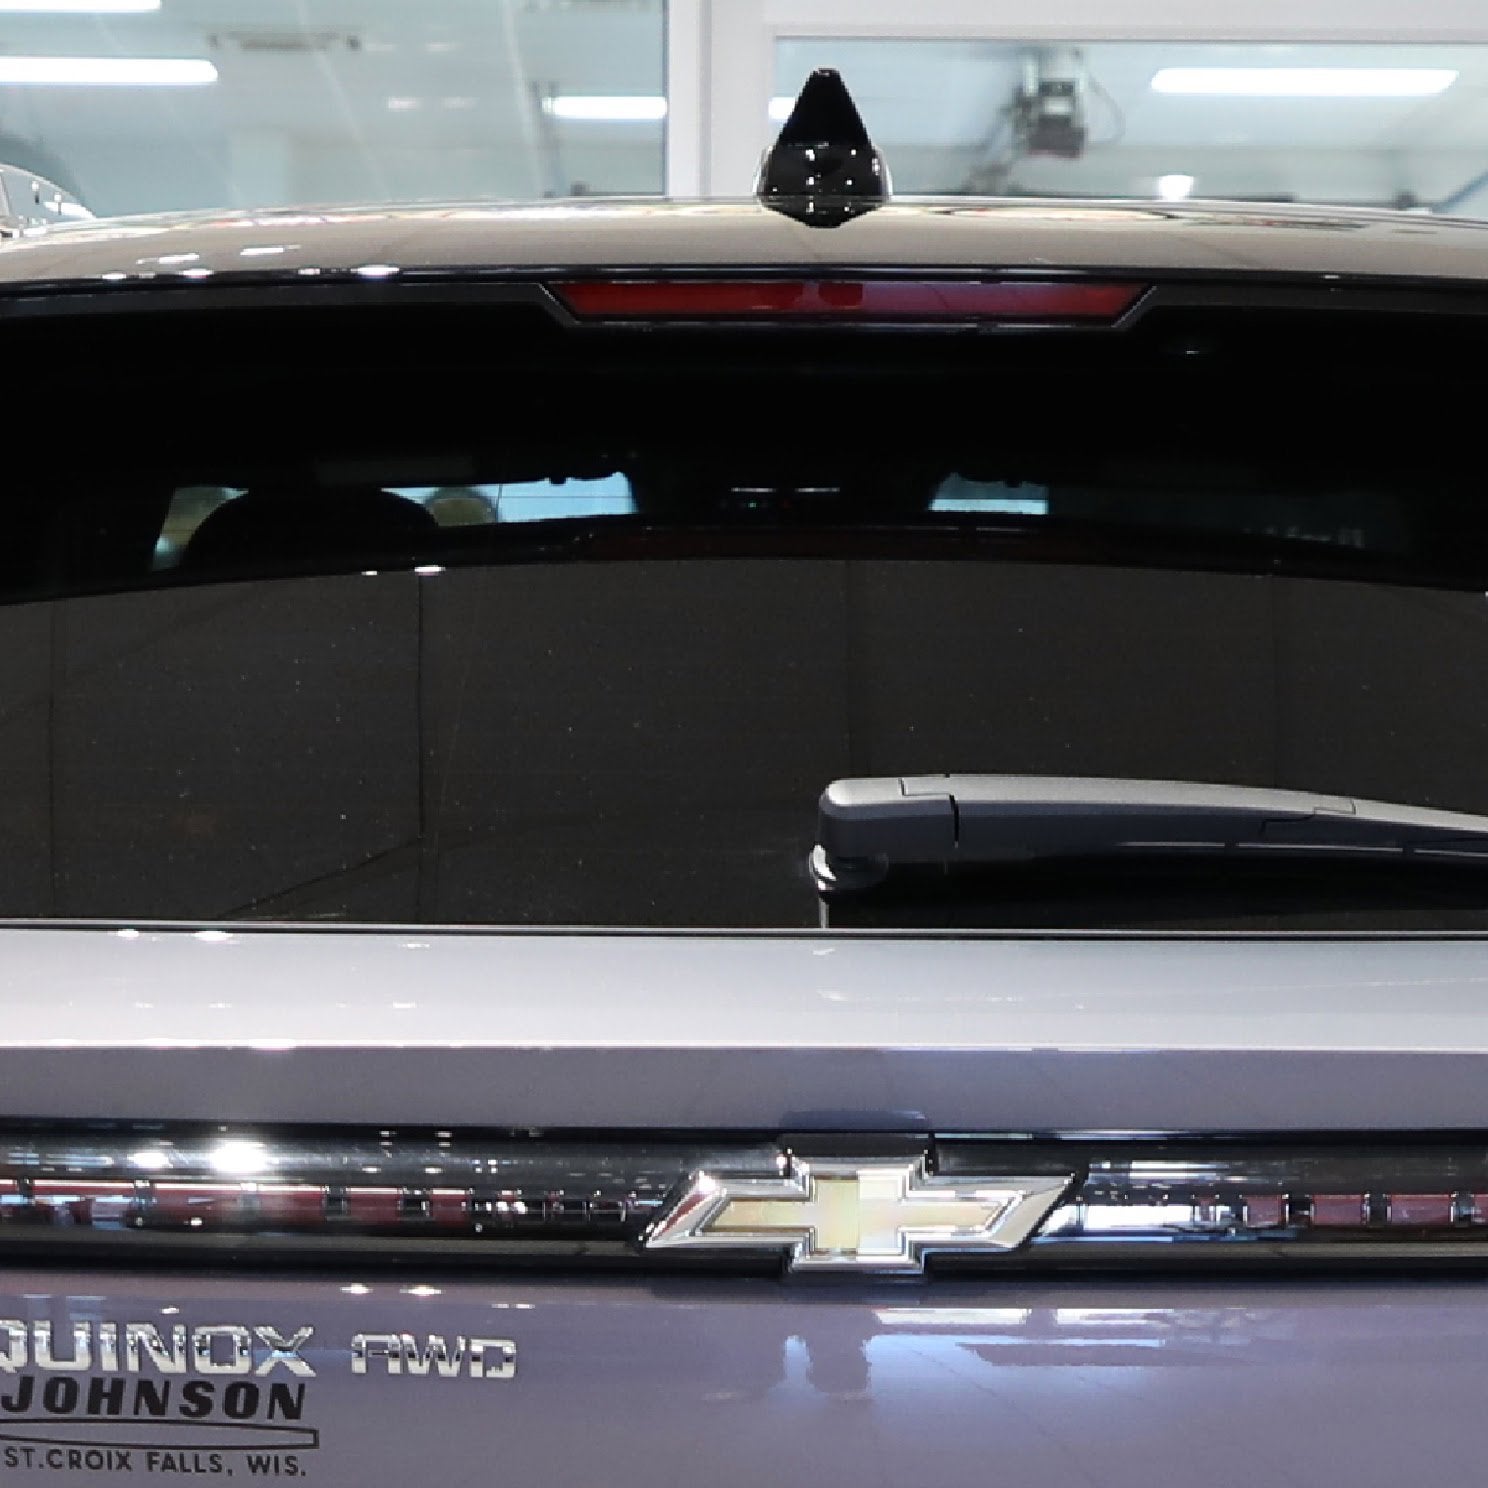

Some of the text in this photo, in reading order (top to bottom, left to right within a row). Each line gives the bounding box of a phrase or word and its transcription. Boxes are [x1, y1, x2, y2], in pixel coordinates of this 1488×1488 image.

[350, 1333, 516, 1379] AWD
[0, 1376, 307, 1420] JOHNSON
[4, 1447, 307, 1477] ST.CROIX FALLS, WIS.
